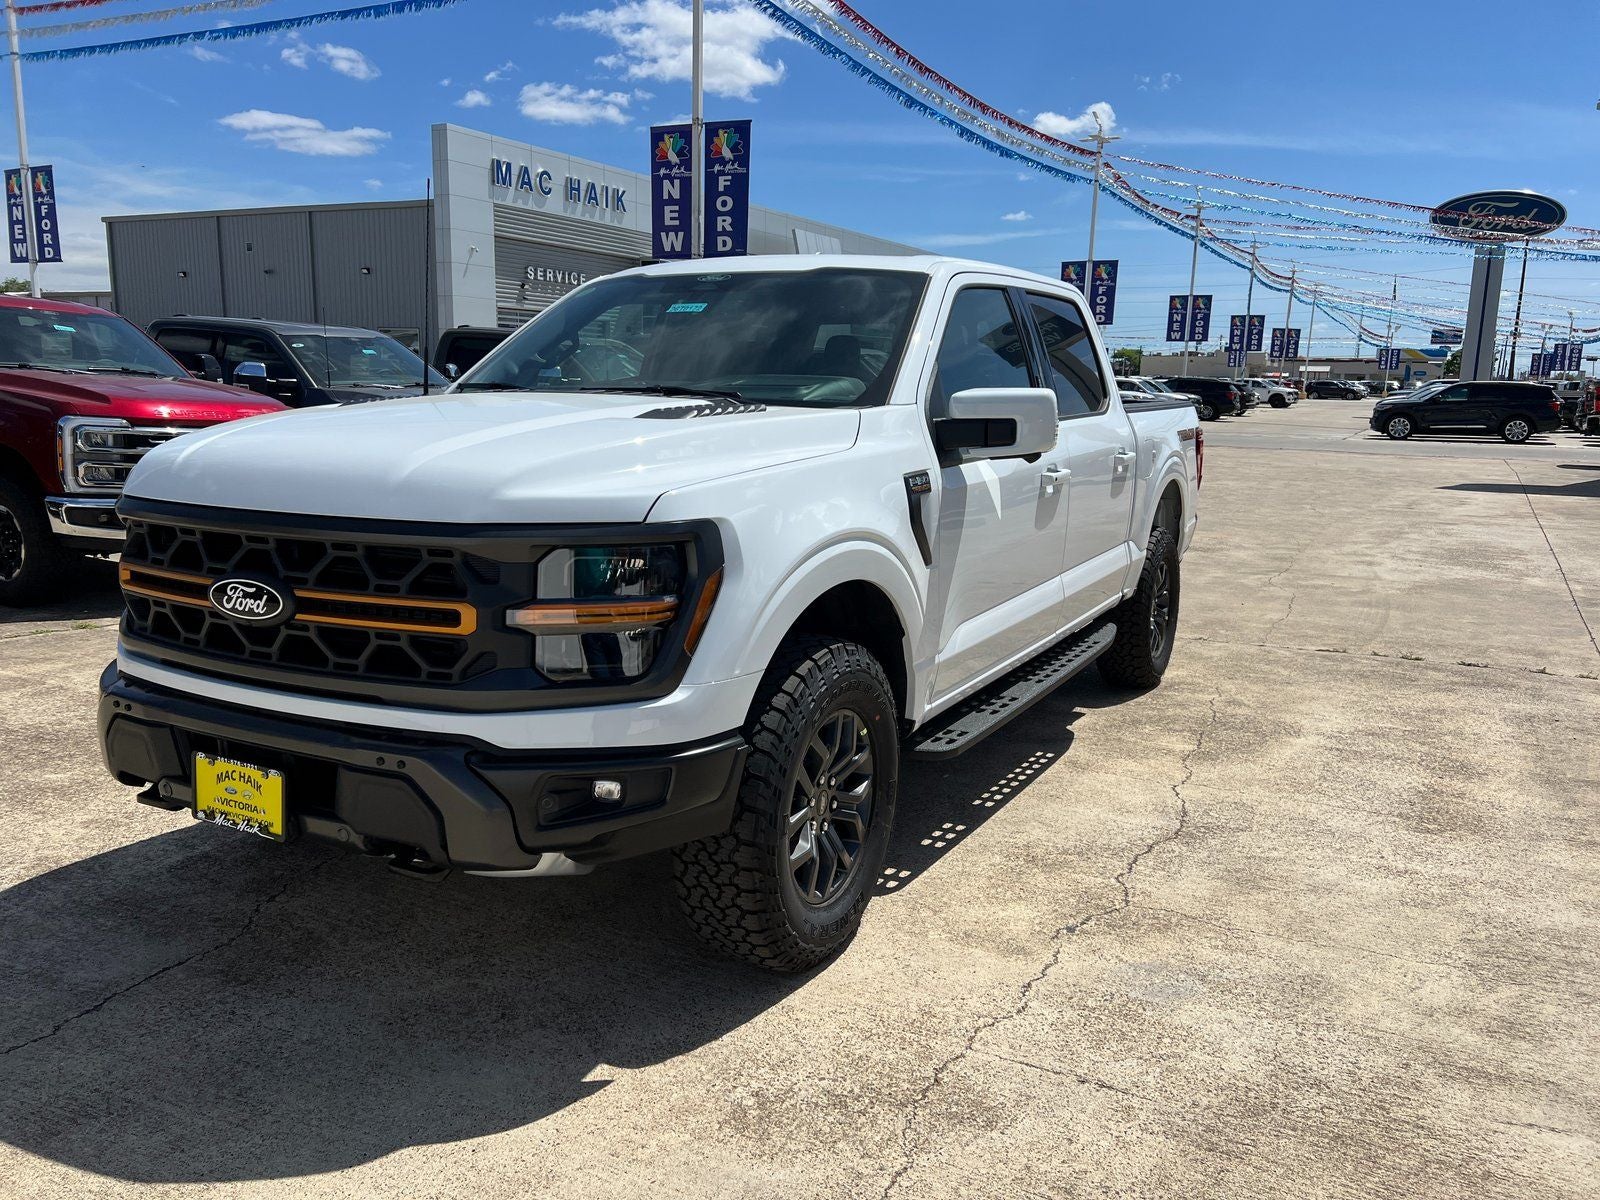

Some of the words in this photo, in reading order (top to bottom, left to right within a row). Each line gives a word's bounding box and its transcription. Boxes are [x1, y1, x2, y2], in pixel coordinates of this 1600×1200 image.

[493, 158, 552, 197] MAC
[566, 176, 627, 213] HAIK
[660, 179, 684, 252] NEW
[715, 175, 734, 252] FORD
[1459, 201, 1539, 230] Ford
[12, 206, 27, 258] NEW
[40, 205, 54, 259] FORD
[527, 265, 586, 285] SERVICE
[1096, 286, 1108, 323] FORD
[1170, 313, 1181, 340] NEW
[1194, 313, 1205, 340] FORD
[1231, 329, 1241, 350] NEW
[1250, 329, 1259, 351] FORD
[1272, 340, 1280, 357] NEW
[1288, 340, 1296, 357] FORD
[223, 583, 268, 614] Ford
[216, 770, 237, 785] MAC
[238, 771, 264, 796] HAIK
[220, 796, 259, 815] VICTORIA
